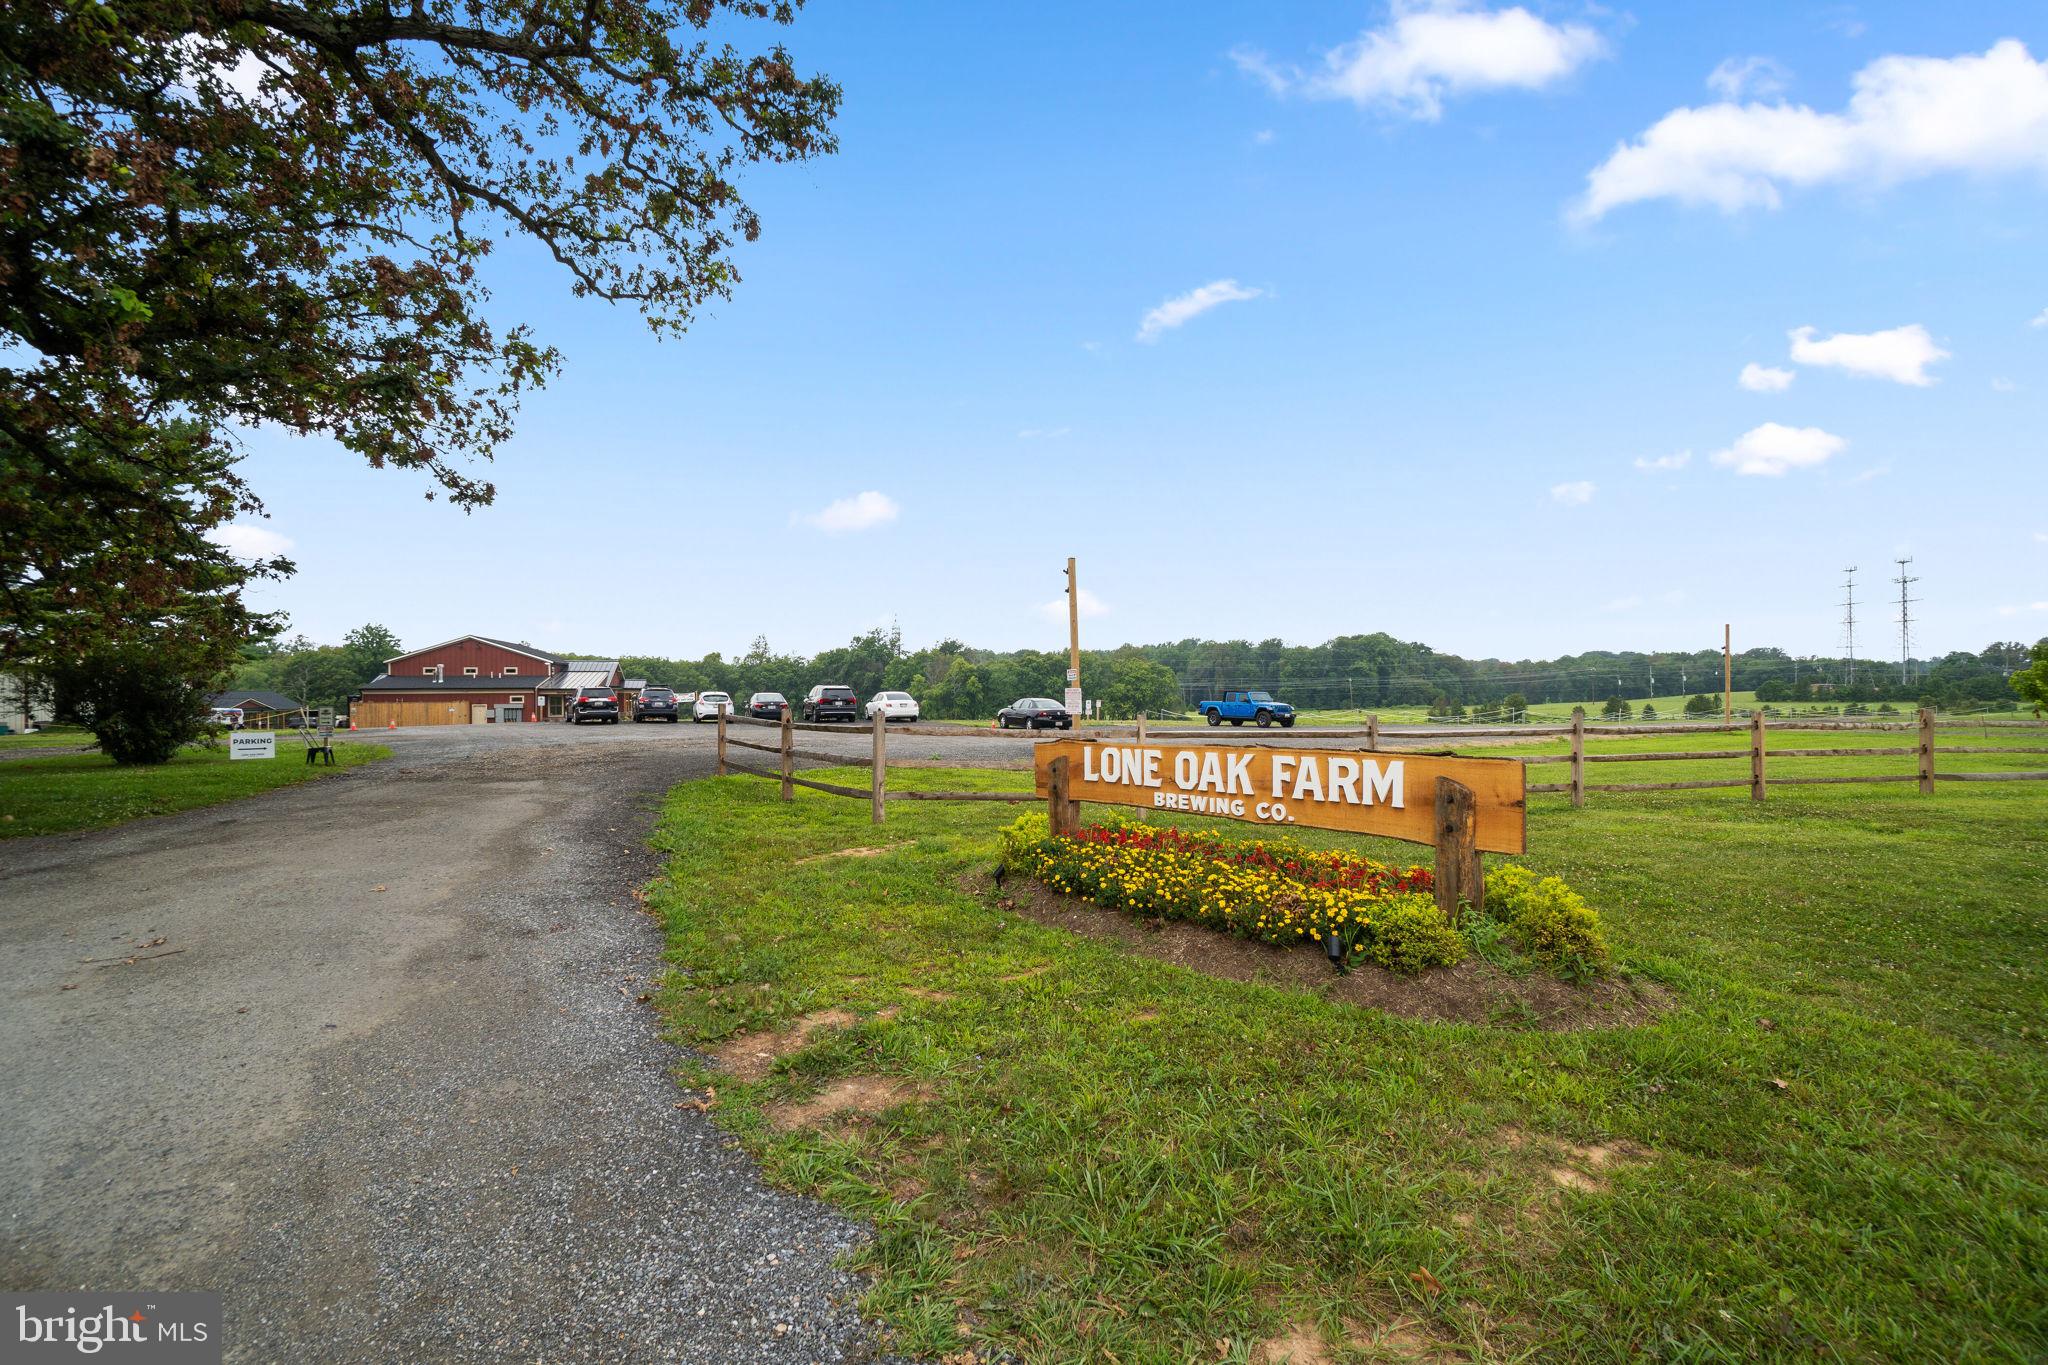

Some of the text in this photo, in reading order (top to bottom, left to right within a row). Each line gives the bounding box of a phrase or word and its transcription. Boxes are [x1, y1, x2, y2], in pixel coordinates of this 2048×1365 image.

[1083, 746, 1405, 809] LONE OAK FARM
[1154, 792, 1295, 822] BREWING CO.
